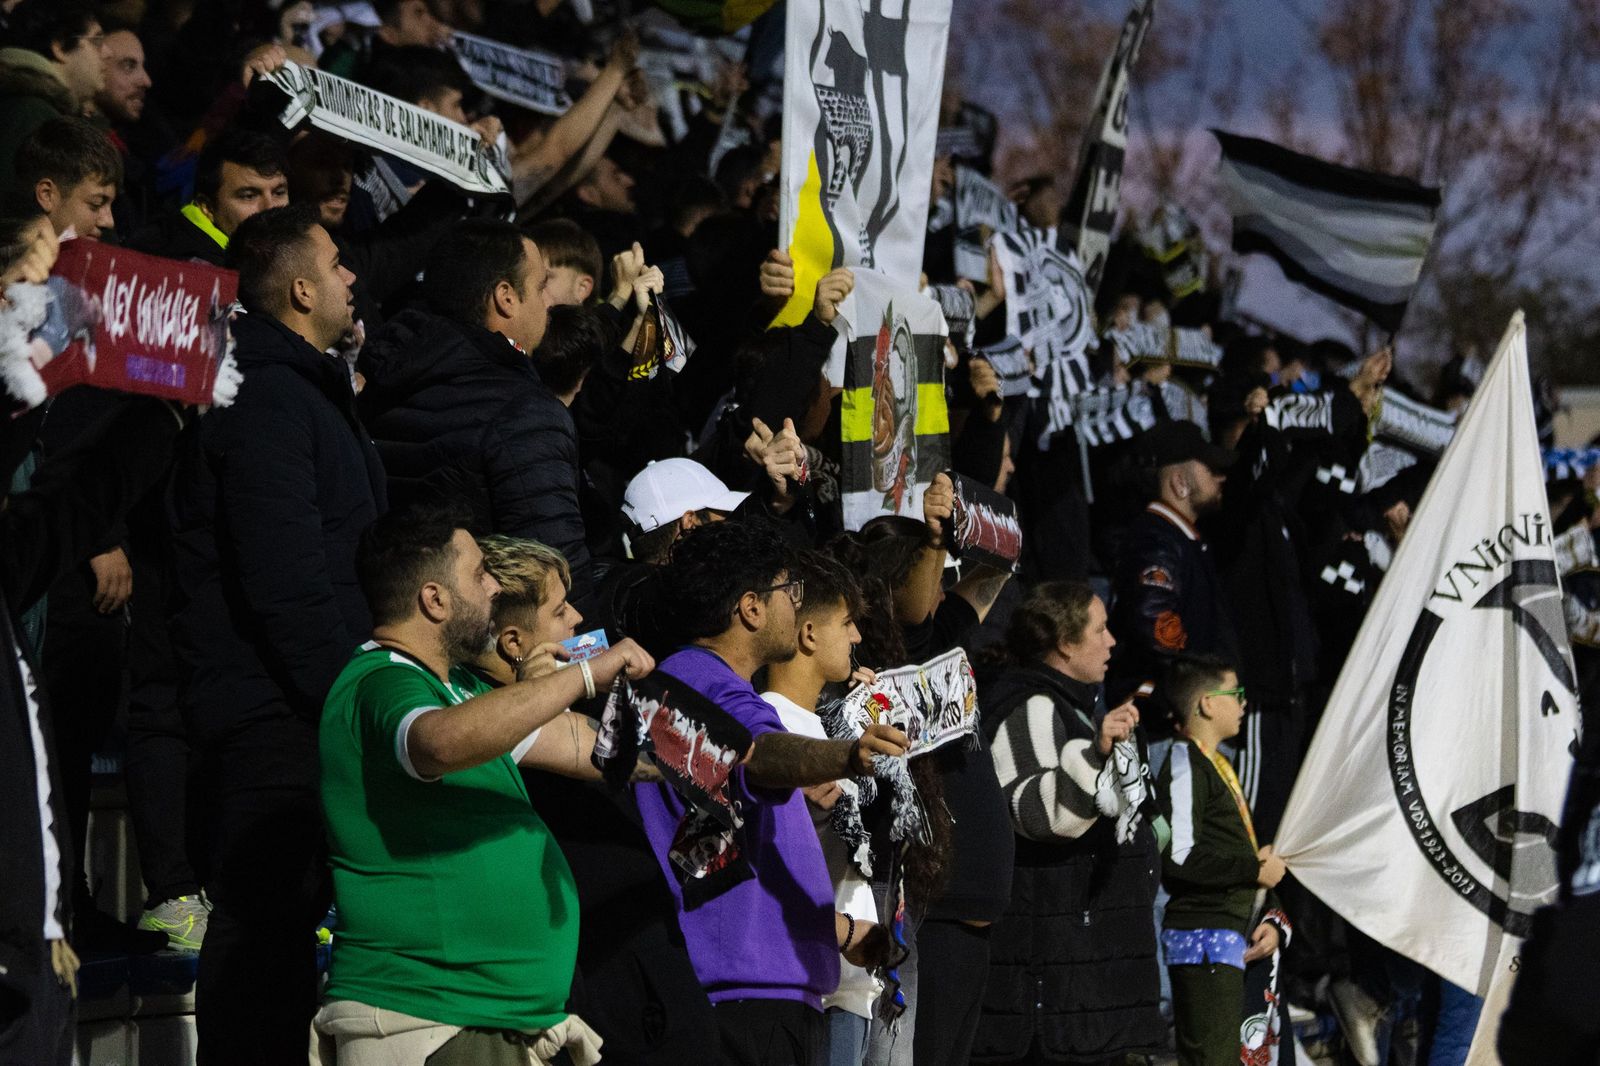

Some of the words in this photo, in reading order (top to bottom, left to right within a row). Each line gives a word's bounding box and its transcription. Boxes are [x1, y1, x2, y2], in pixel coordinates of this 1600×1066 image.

[319, 71, 381, 130] UNIONISTAS
[382, 95, 398, 137] DE
[398, 104, 456, 161] SALAMANCA
[457, 133, 471, 168] CF
[1408, 799, 1429, 830] VDS
[1420, 831, 1476, 896] 1923-2013
